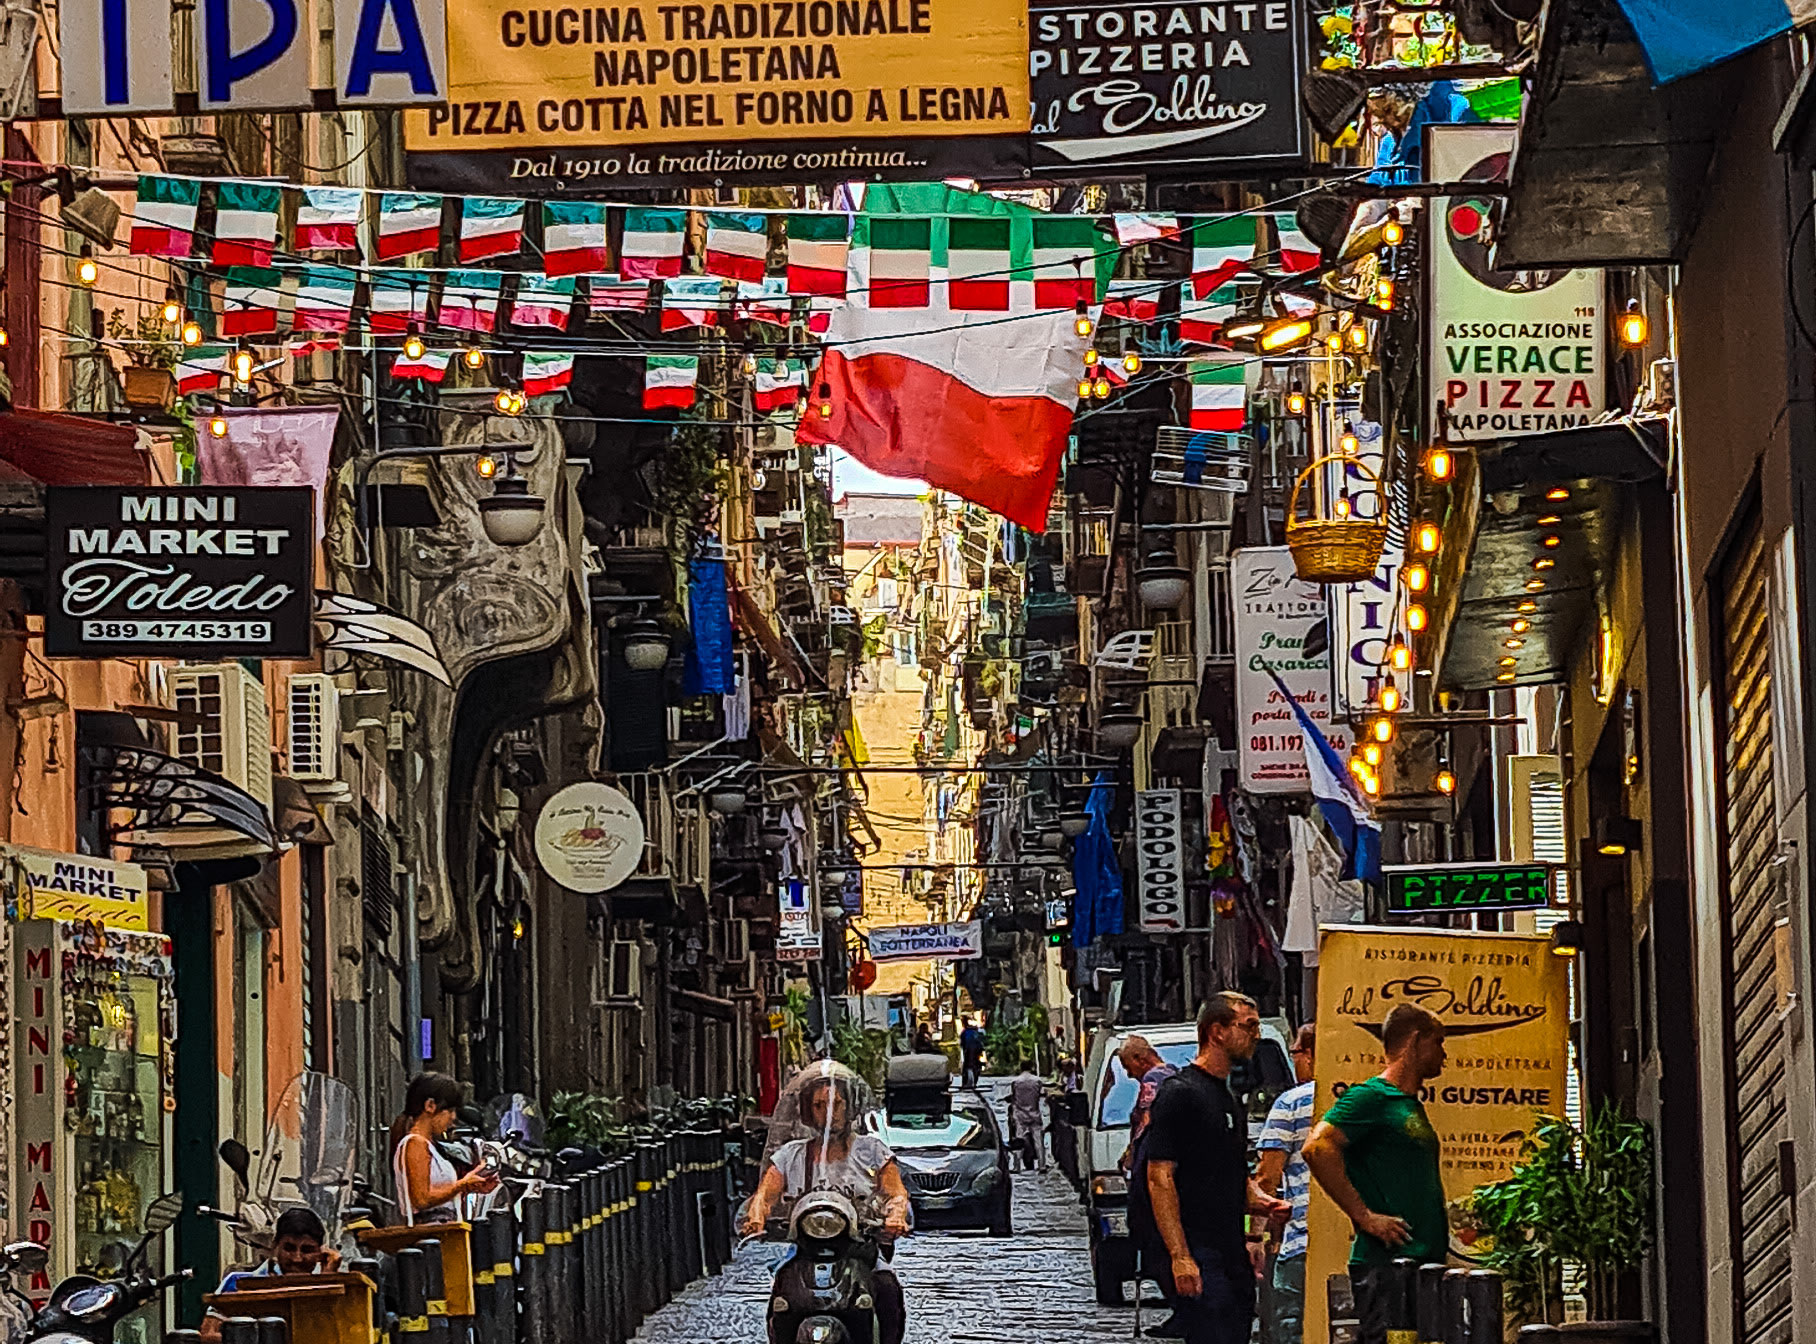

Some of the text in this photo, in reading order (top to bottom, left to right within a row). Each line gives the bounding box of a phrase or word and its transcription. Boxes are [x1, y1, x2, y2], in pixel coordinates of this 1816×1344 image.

[500, 6, 646, 48] CUCINA
[1039, 2, 1288, 42] STORANTE
[594, 45, 841, 87] NAPOLETANA
[1030, 39, 1250, 77] PIZZERIA
[428, 86, 1010, 137] PIZZA COTTA NEL FORNO A LEGNA
[1030, 99, 1061, 134] al
[510, 156, 556, 179] Dal
[562, 158, 622, 180] 1910
[627, 153, 651, 175] la
[658, 149, 788, 174] tradizione
[1574, 307, 1595, 317] 118
[1444, 323, 1593, 339] ASSOCIAZIONE
[1446, 345, 1594, 374] VERACE
[1447, 379, 1593, 408] PIZZA
[1450, 413, 1592, 431] NAPOLETANA
[121, 496, 236, 522] MINI
[68, 529, 290, 555] MARKET
[61, 558, 296, 617] Toledo
[1245, 602, 1326, 614] TRATTORI
[88, 623, 267, 639] 389 4745319
[1266, 689, 1317, 704] Prndi
[1141, 795, 1179, 915] PODOLOGO
[28, 872, 141, 903] MARKET
[54, 862, 115, 884] MINI
[1404, 871, 1546, 907] PIZZER
[900, 924, 948, 937] NAPOLI
[1364, 948, 1531, 967] RISTORANTE PIZZERIA
[1336, 986, 1374, 1017] dal
[26, 947, 52, 1096] MINI
[1455, 1057, 1552, 1071] NAPOLETANA
[1442, 1086, 1550, 1106] GUSTARE
